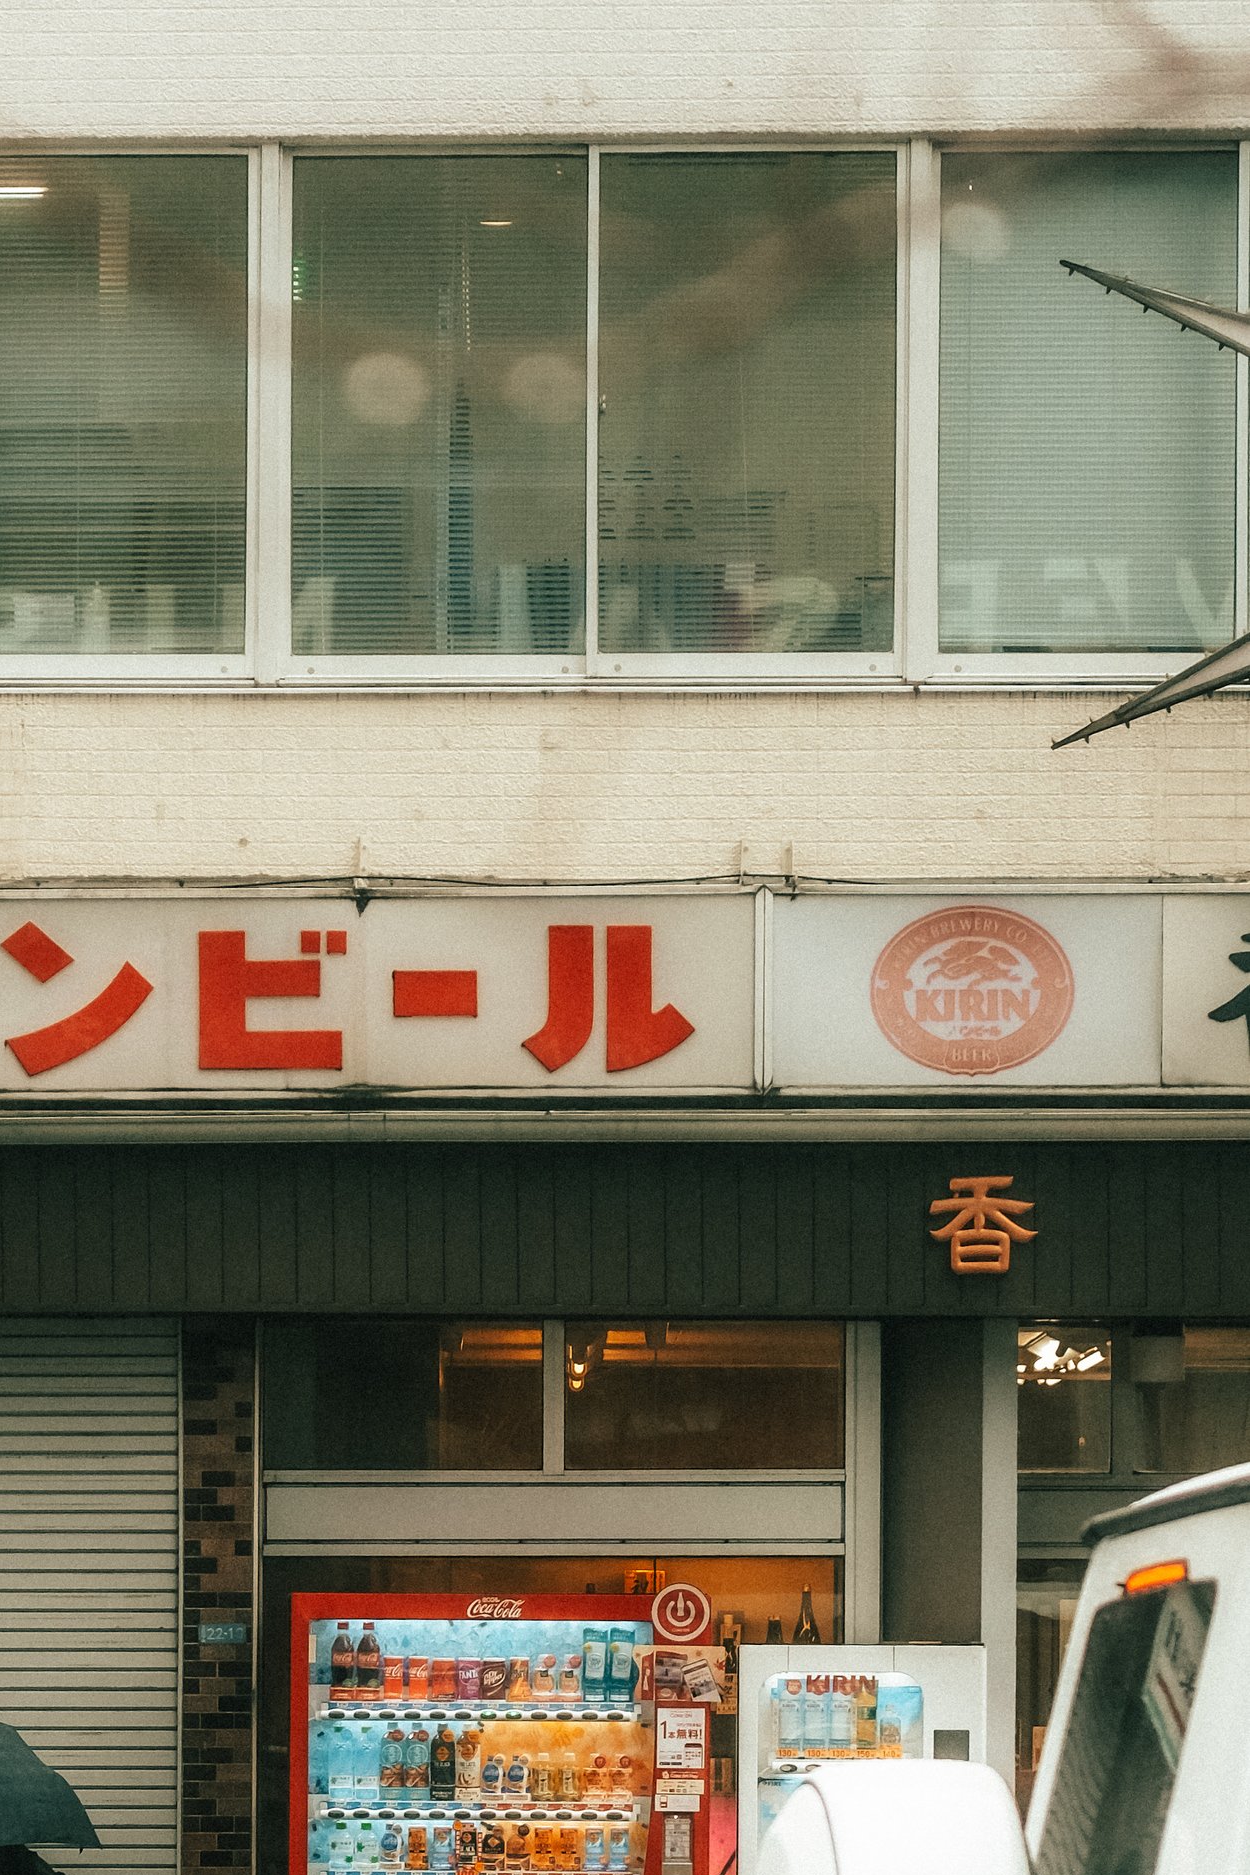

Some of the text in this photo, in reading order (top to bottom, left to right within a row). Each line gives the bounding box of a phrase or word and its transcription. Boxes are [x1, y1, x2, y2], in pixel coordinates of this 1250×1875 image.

[914, 989, 1030, 1021] KIRIN
[952, 1048, 992, 1062] BEER
[930, 1176, 1039, 1274] 香
[466, 1598, 526, 1618] Coca-Cola
[806, 1675, 876, 1694] KIRIN
